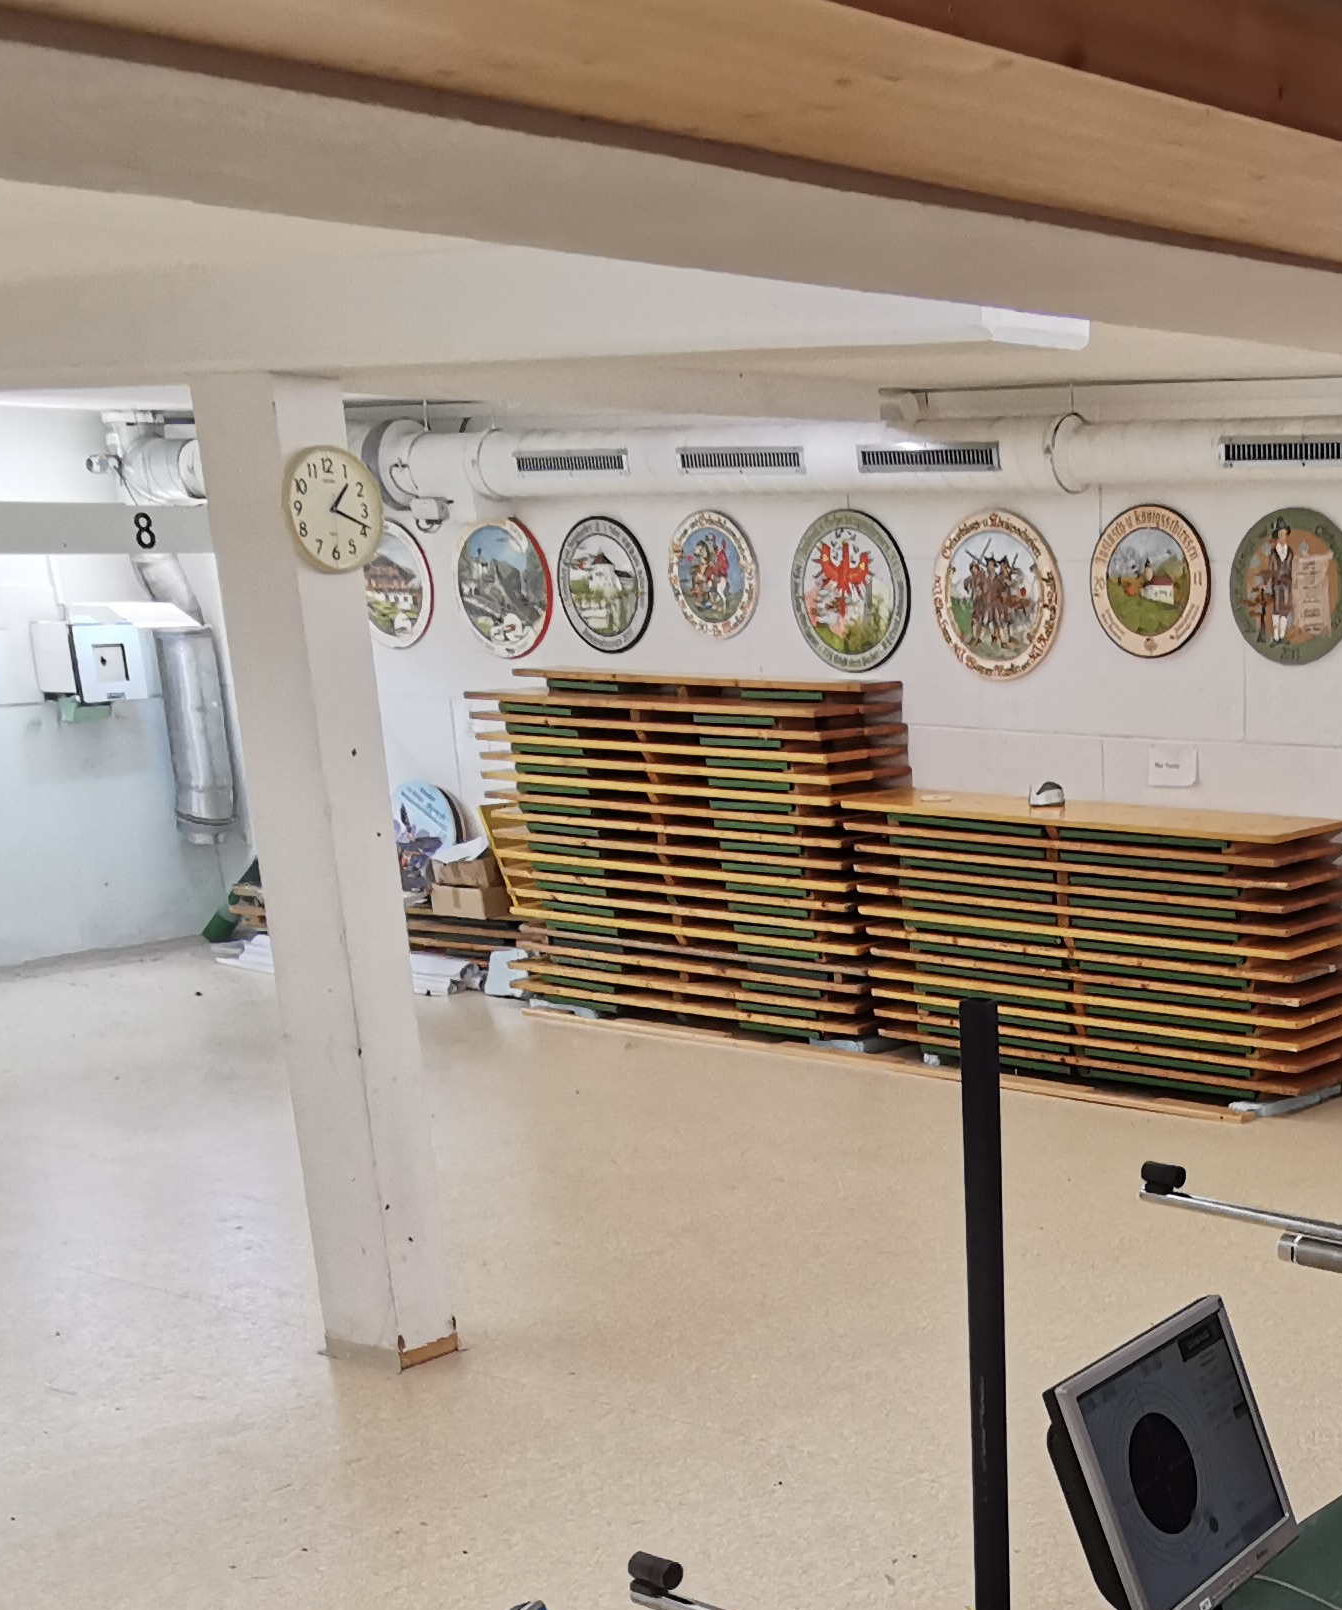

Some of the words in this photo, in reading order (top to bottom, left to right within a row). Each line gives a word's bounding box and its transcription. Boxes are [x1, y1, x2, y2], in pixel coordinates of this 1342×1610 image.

[307, 463, 317, 478] 11
[321, 458, 333, 474] 12
[342, 464, 347, 478] 1
[294, 478, 307, 495] 10
[355, 482, 363, 497] 2
[294, 500, 302, 516] 9
[361, 503, 368, 519] 3
[134, 512, 156, 549] 8
[299, 521, 308, 537] 8
[315, 539, 323, 554] 7
[332, 545, 340, 560] 6
[349, 539, 357, 554] 5
